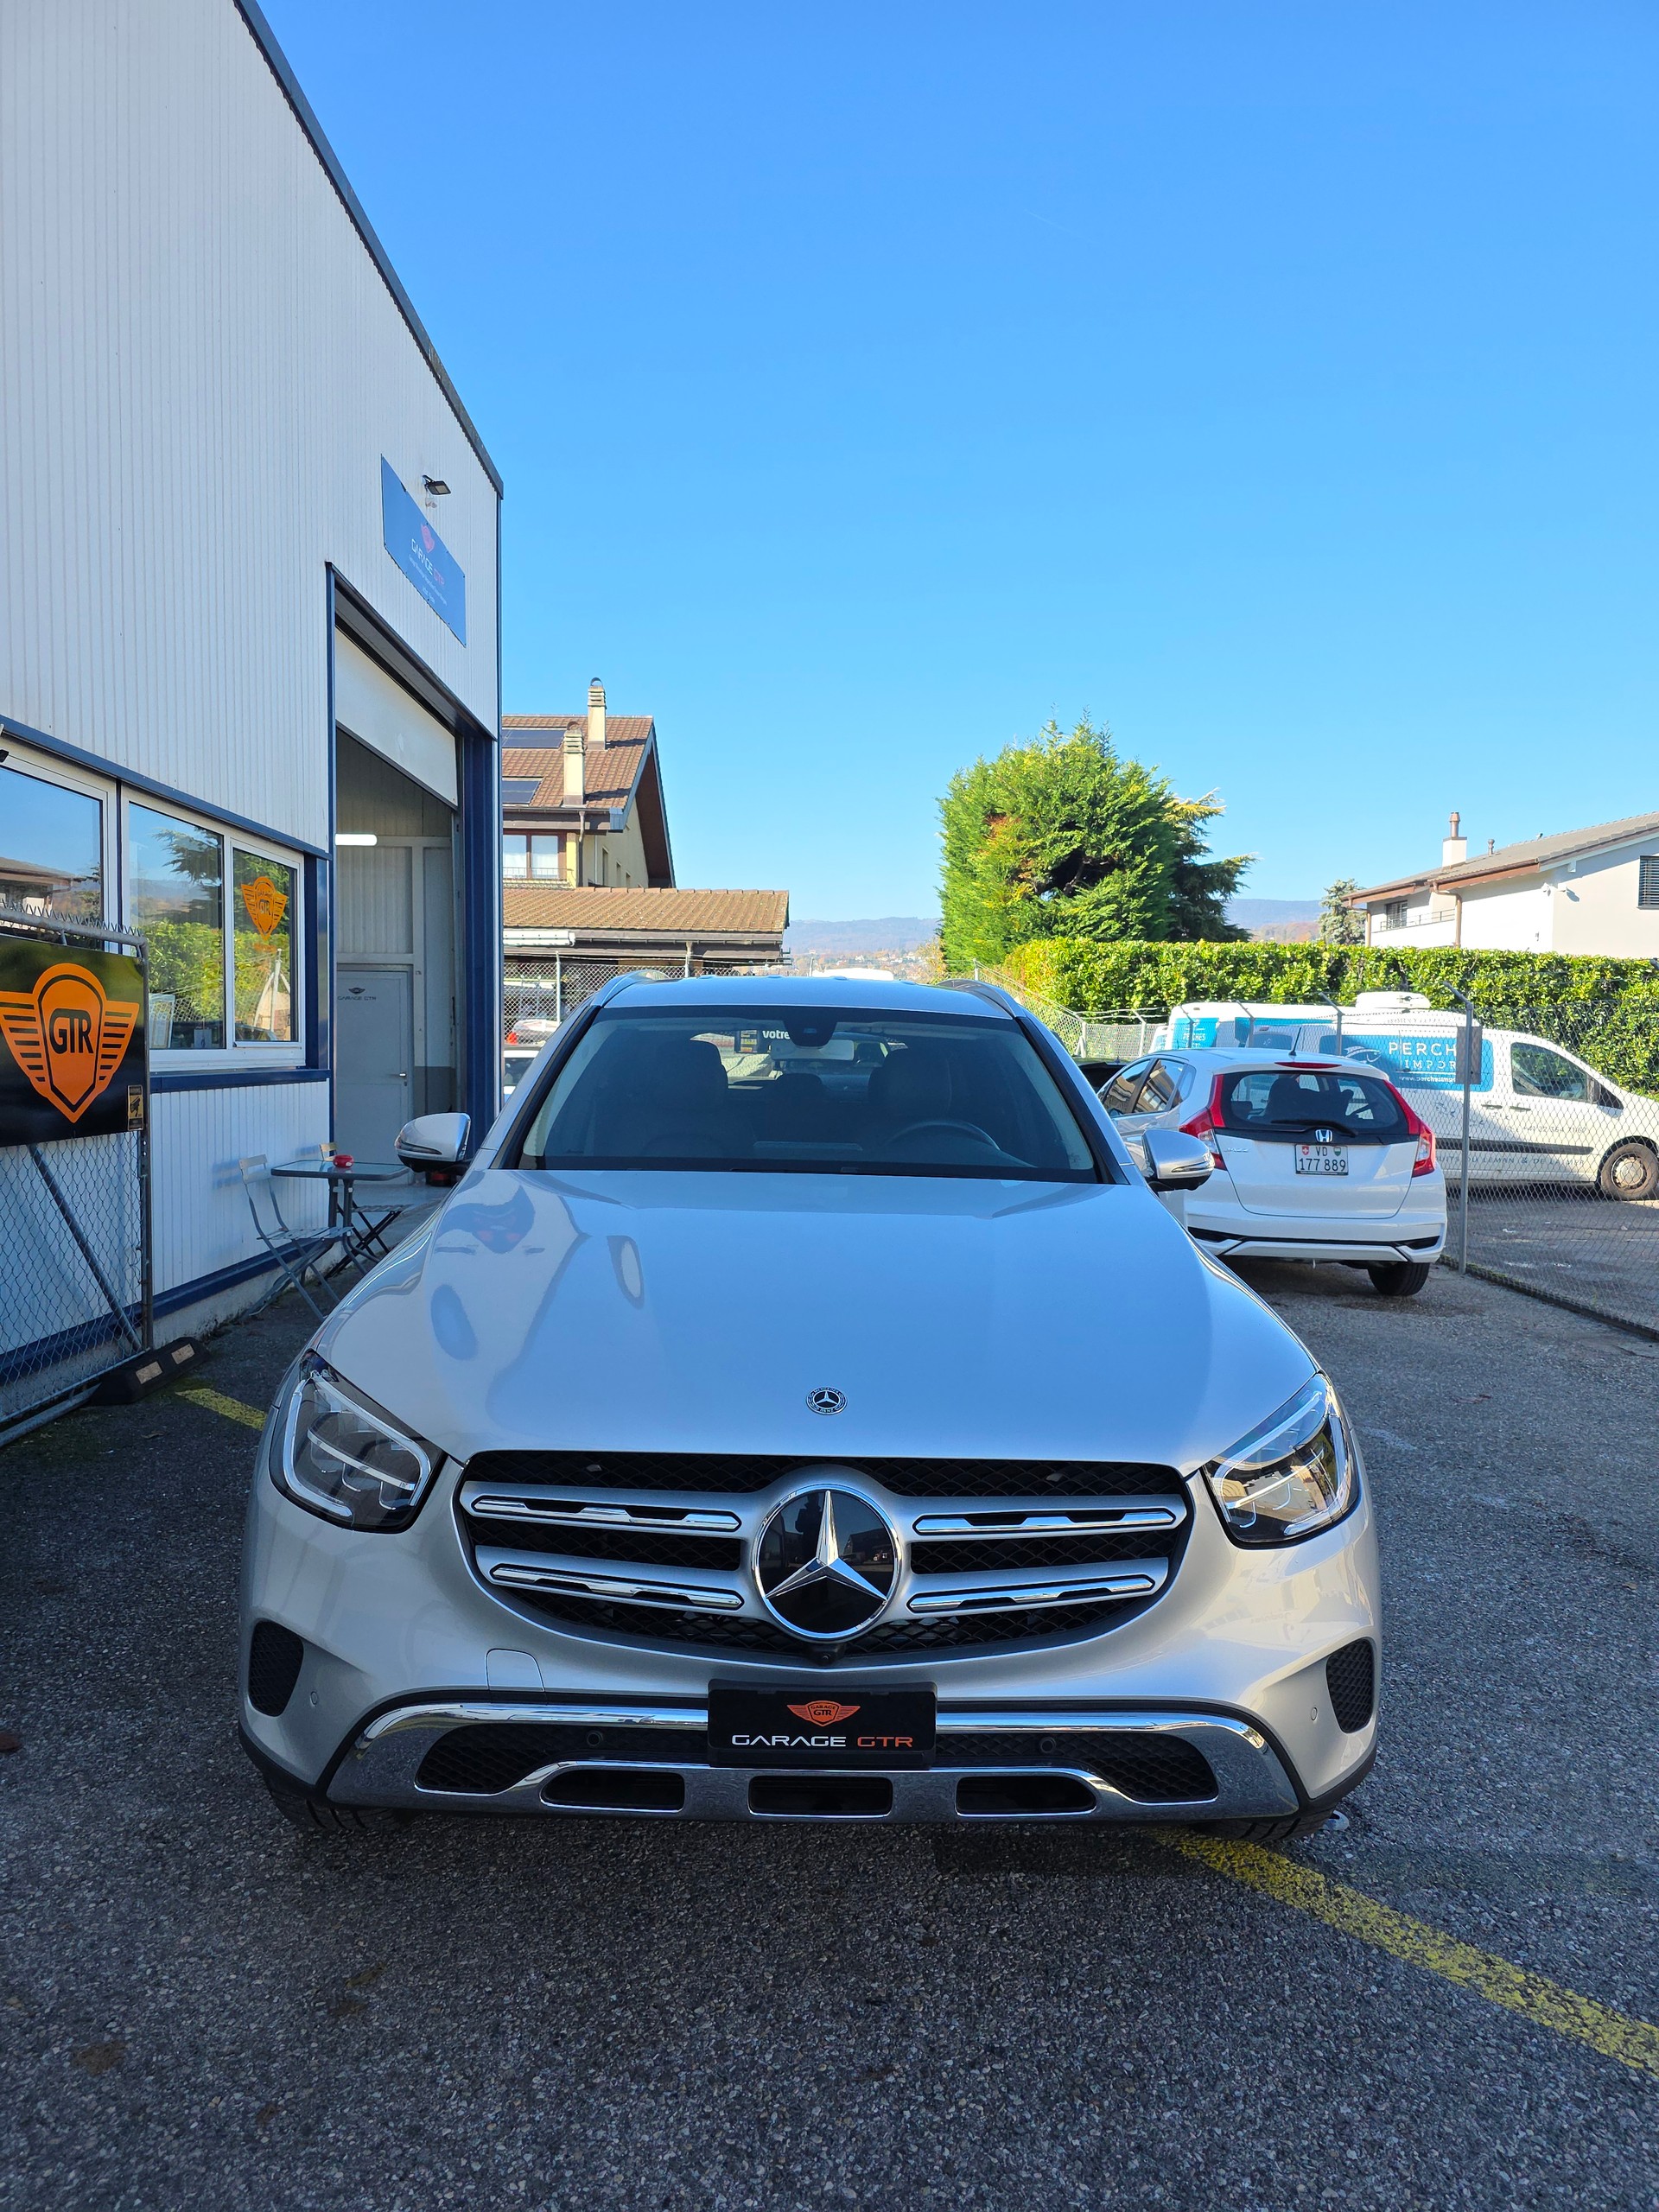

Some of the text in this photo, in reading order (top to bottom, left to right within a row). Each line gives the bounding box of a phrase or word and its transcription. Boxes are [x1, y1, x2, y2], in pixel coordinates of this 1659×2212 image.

[49, 1007, 94, 1054] GTR
[762, 1029, 791, 1039] votre
[1315, 1146, 1328, 1157] VD
[1299, 1158, 1346, 1172] 177 889
[732, 1734, 913, 1748] GARAGE GTR
